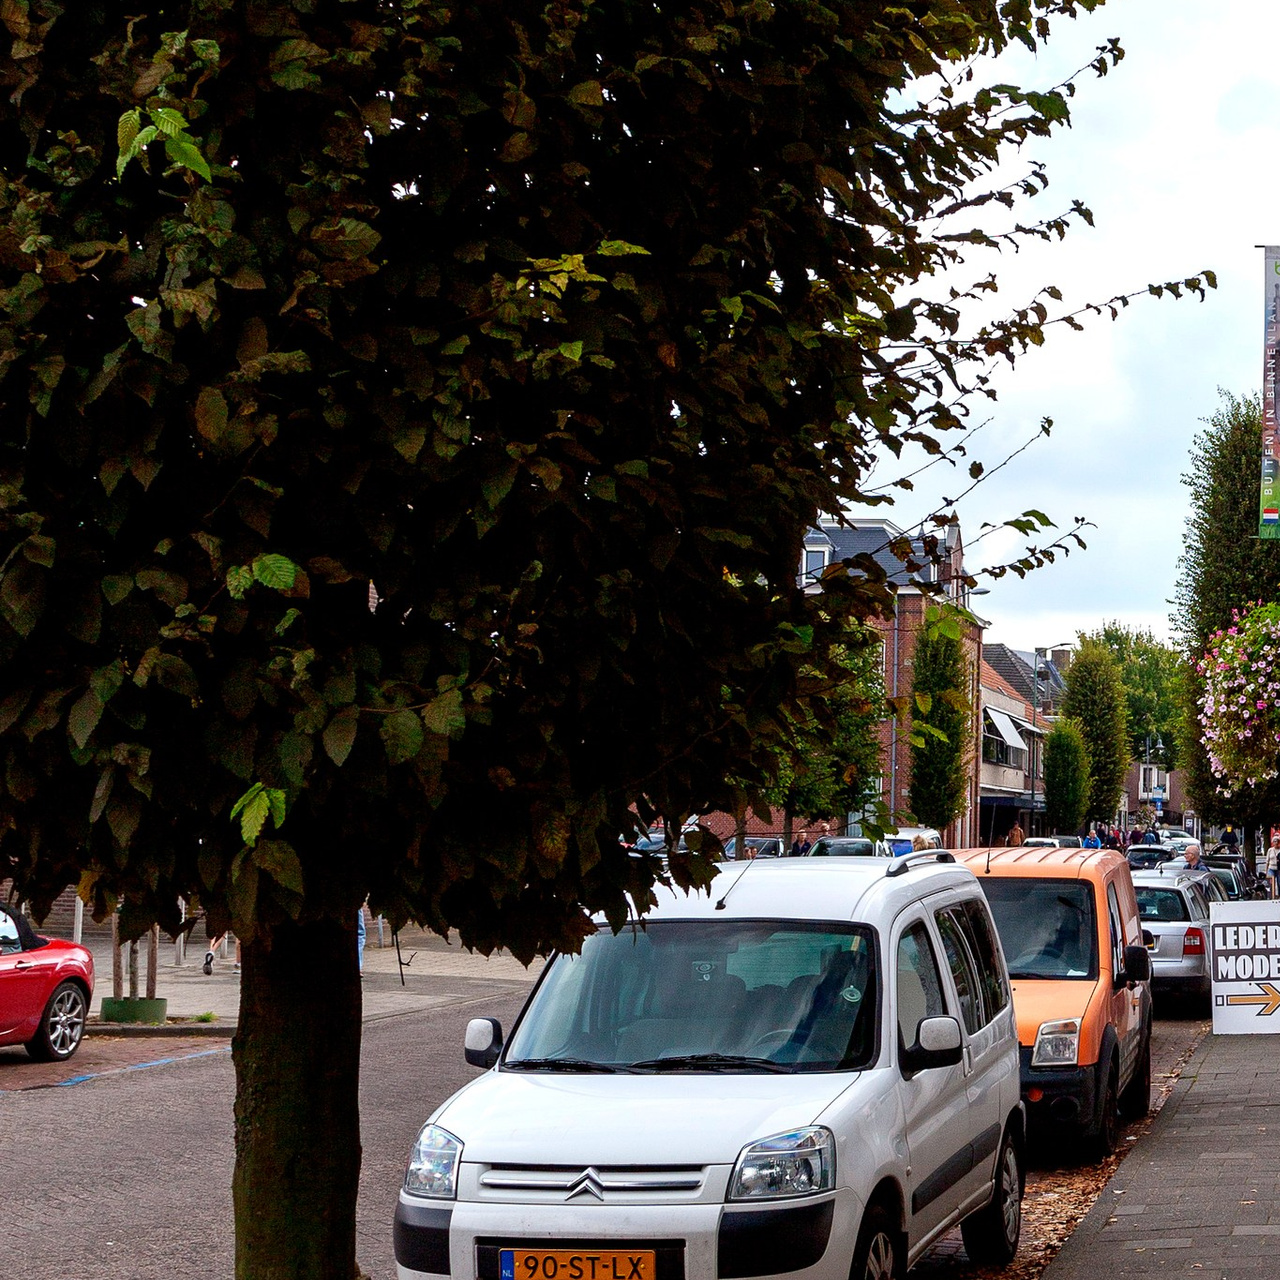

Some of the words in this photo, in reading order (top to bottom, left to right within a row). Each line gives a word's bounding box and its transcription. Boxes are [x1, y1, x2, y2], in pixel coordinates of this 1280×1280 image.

[1266, 293, 1277, 398] BINNENLAN
[1266, 409, 1275, 425] IN
[1264, 436, 1275, 496] BUITEN
[502, 1269, 513, 1278] NL
[523, 1255, 643, 1280] 90-ST-LX
